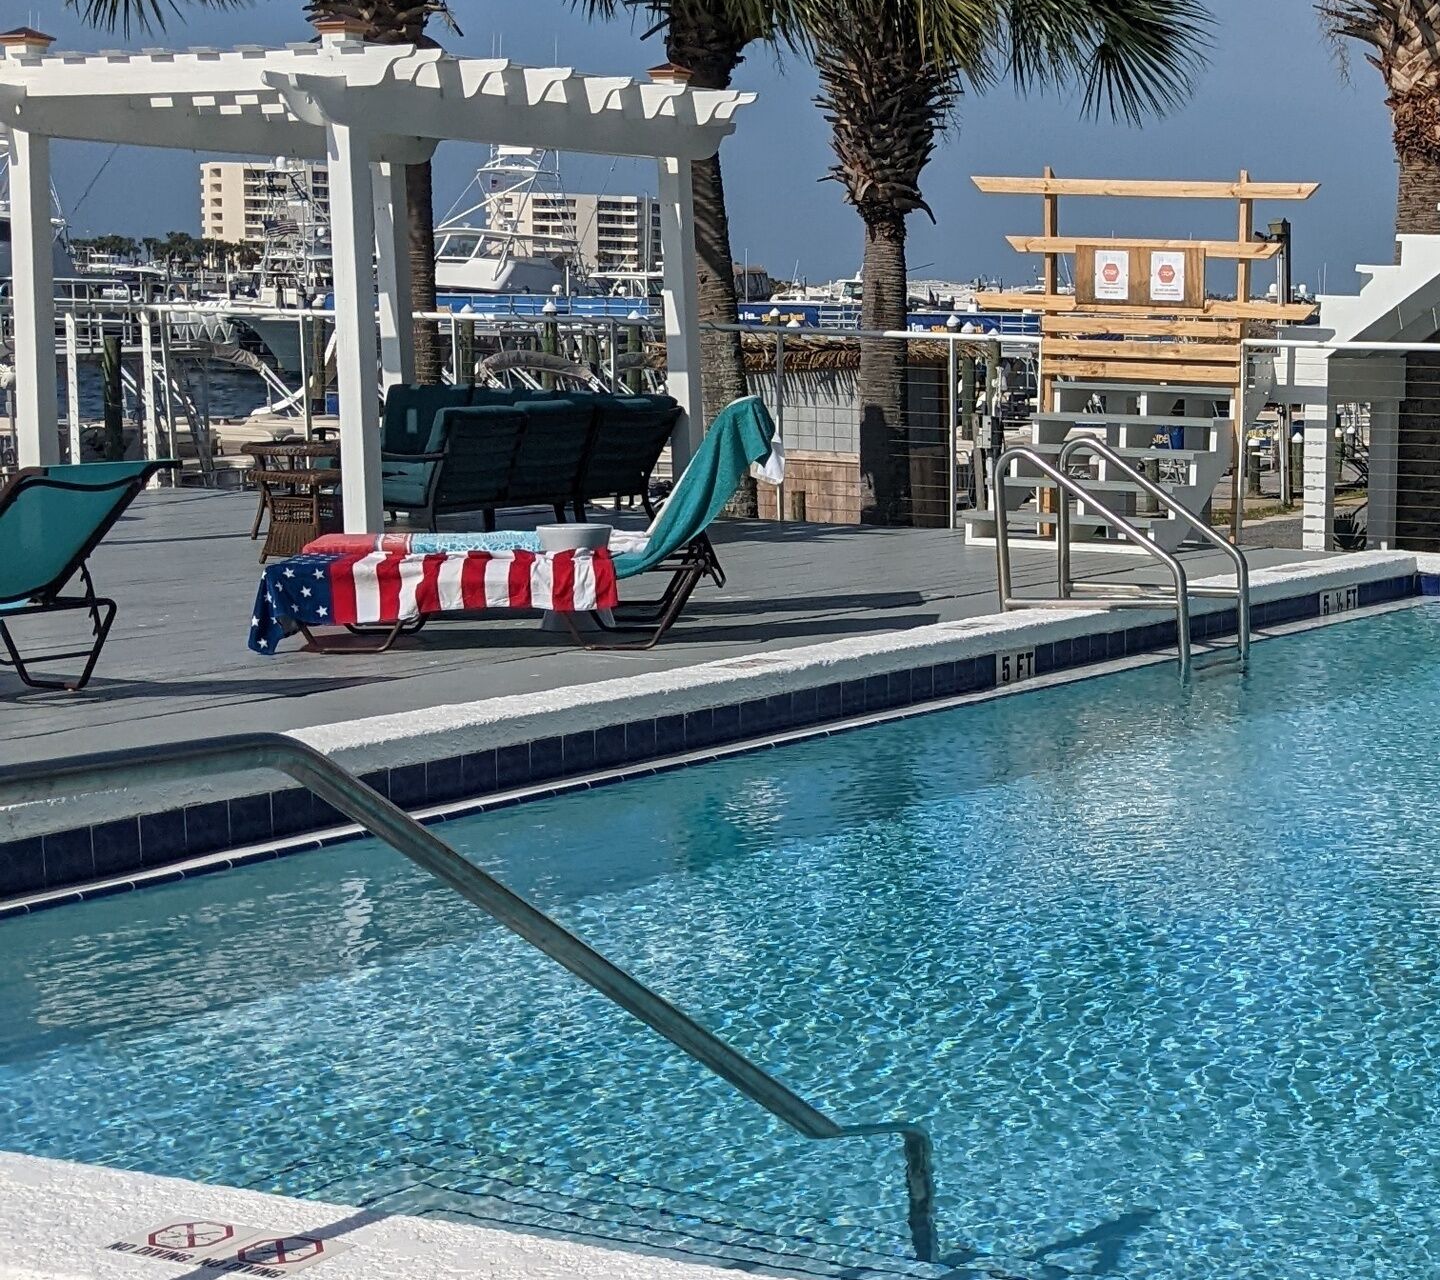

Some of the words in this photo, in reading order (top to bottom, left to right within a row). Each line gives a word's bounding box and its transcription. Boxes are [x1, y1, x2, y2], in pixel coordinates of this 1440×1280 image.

[1323, 594, 1330, 615] 5
[1346, 588, 1357, 609] FT
[1001, 655, 1010, 681] 5
[1016, 651, 1034, 679] FT
[104, 1241, 138, 1252] NO
[131, 1246, 195, 1263] DIVING
[195, 1257, 228, 1268] NO
[222, 1262, 287, 1279] DIVING
